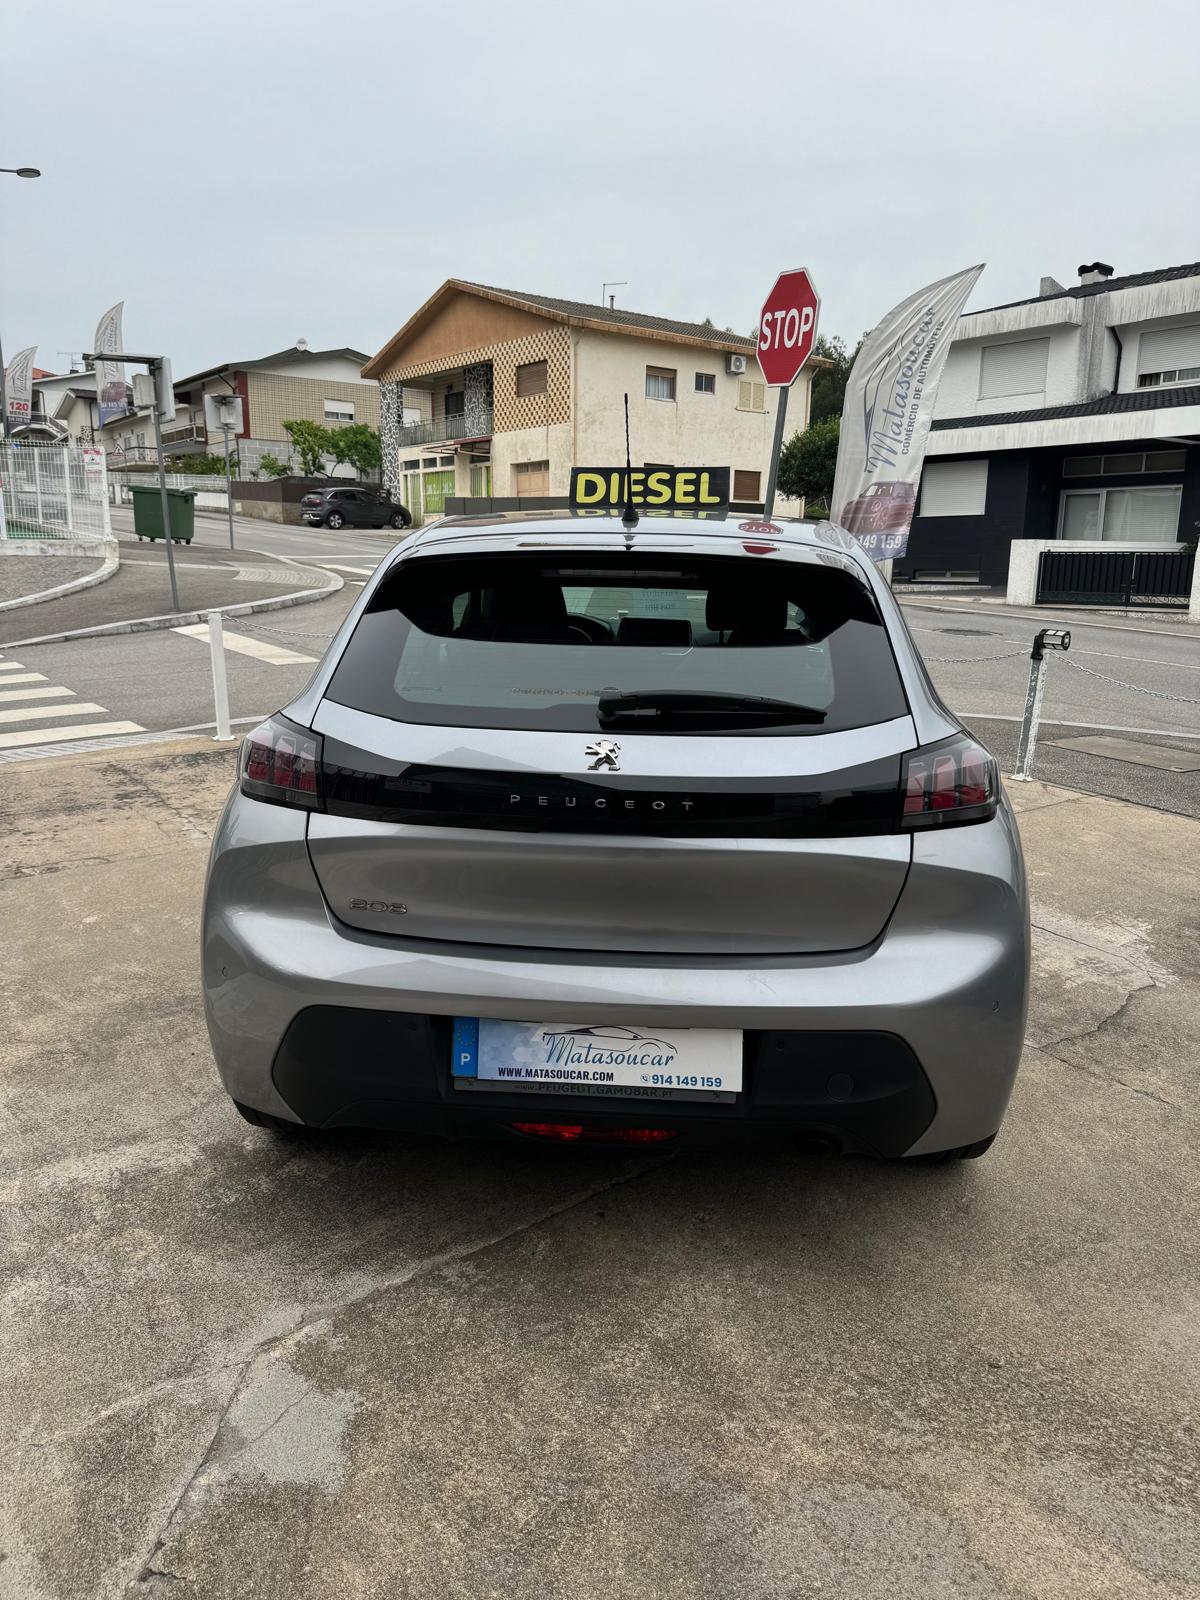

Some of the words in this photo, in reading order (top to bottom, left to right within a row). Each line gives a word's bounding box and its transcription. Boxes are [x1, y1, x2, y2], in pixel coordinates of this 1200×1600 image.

[760, 306, 814, 351] STOP
[917, 320, 945, 385] AUTOMÓVEIS
[867, 307, 936, 473] Matasoucar
[913, 387, 923, 400] DE
[9, 401, 29, 411] 120
[902, 403, 919, 455] COMÉRCIO
[575, 472, 721, 504] DIESEL
[880, 534, 903, 549] 159
[510, 794, 693, 811] PEUGEOT
[350, 898, 408, 915] 208
[460, 1053, 471, 1066] P
[544, 1036, 674, 1067] Matasoucar
[498, 1067, 614, 1082] WWW.MATASOUCAR.COM
[652, 1074, 673, 1086] 914
[675, 1075, 698, 1087] 149
[700, 1076, 722, 1088] 159
